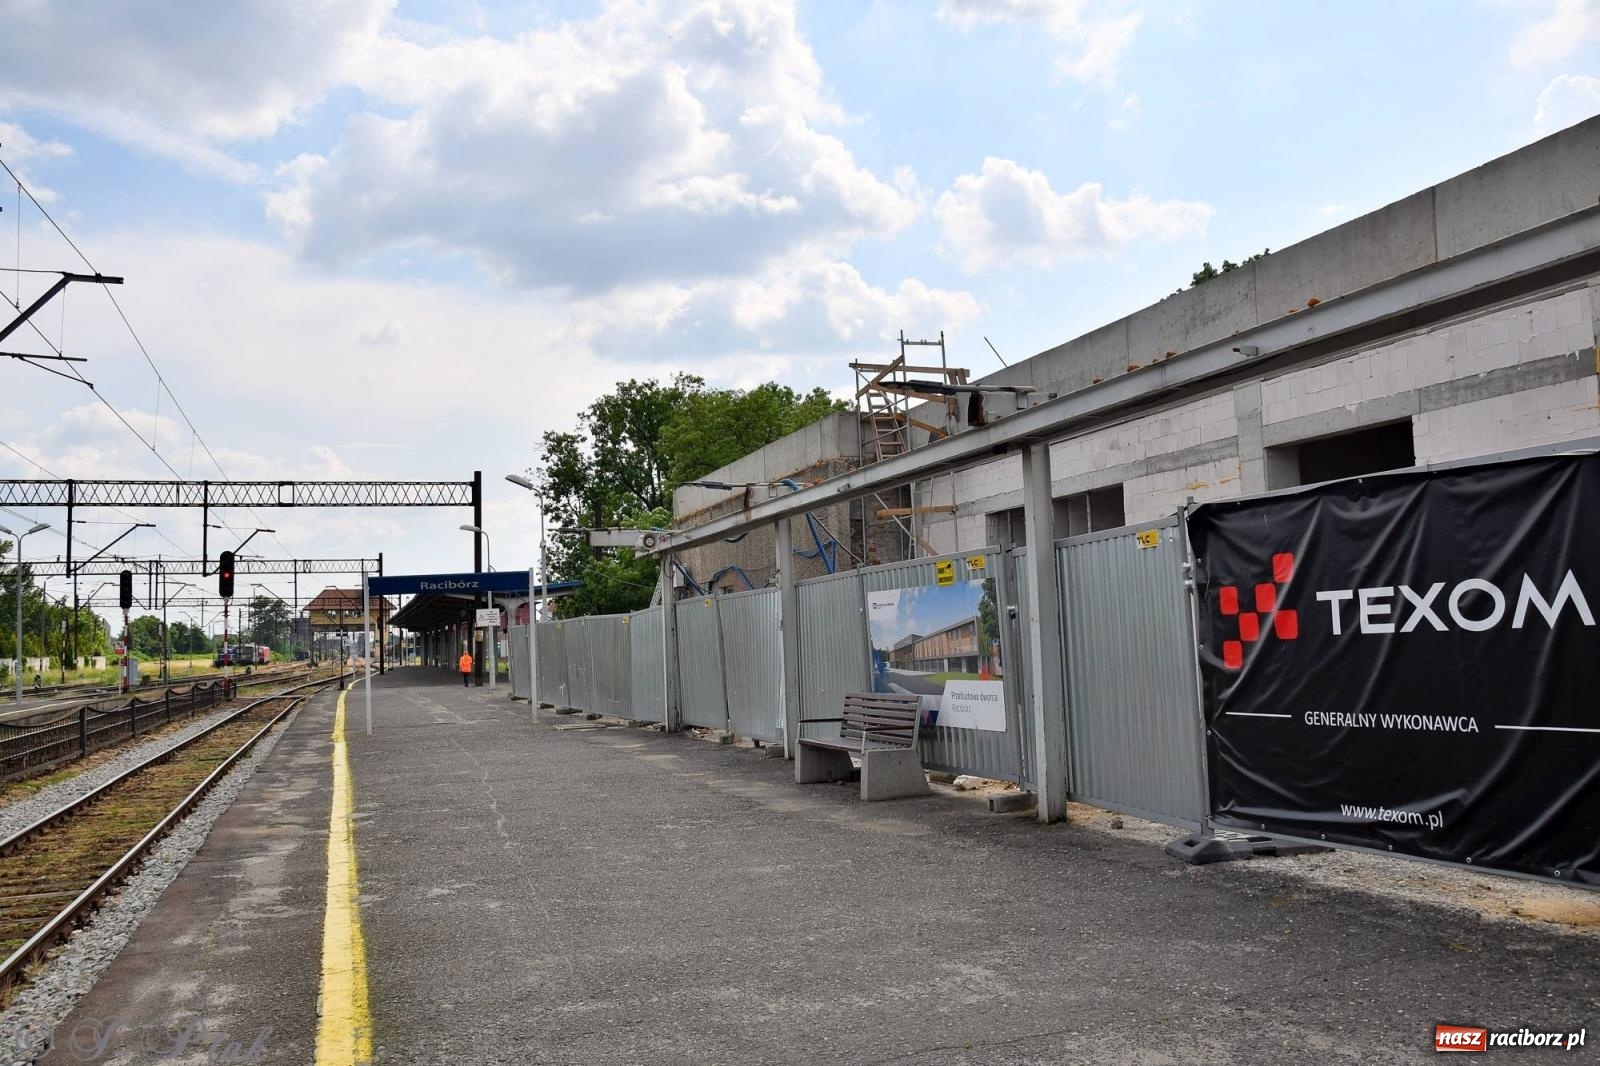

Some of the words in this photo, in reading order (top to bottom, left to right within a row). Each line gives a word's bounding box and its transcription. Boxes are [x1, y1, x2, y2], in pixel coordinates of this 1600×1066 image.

[420, 580, 480, 590] Racibórz
[1316, 569, 1597, 635] TEXOM
[951, 691, 979, 701] Przebudowa
[980, 691, 999, 702] dworca
[1304, 711, 1377, 728] GENERALNY
[1380, 714, 1479, 733] WYKONAWCA
[1340, 803, 1444, 830] www.texom.pl
